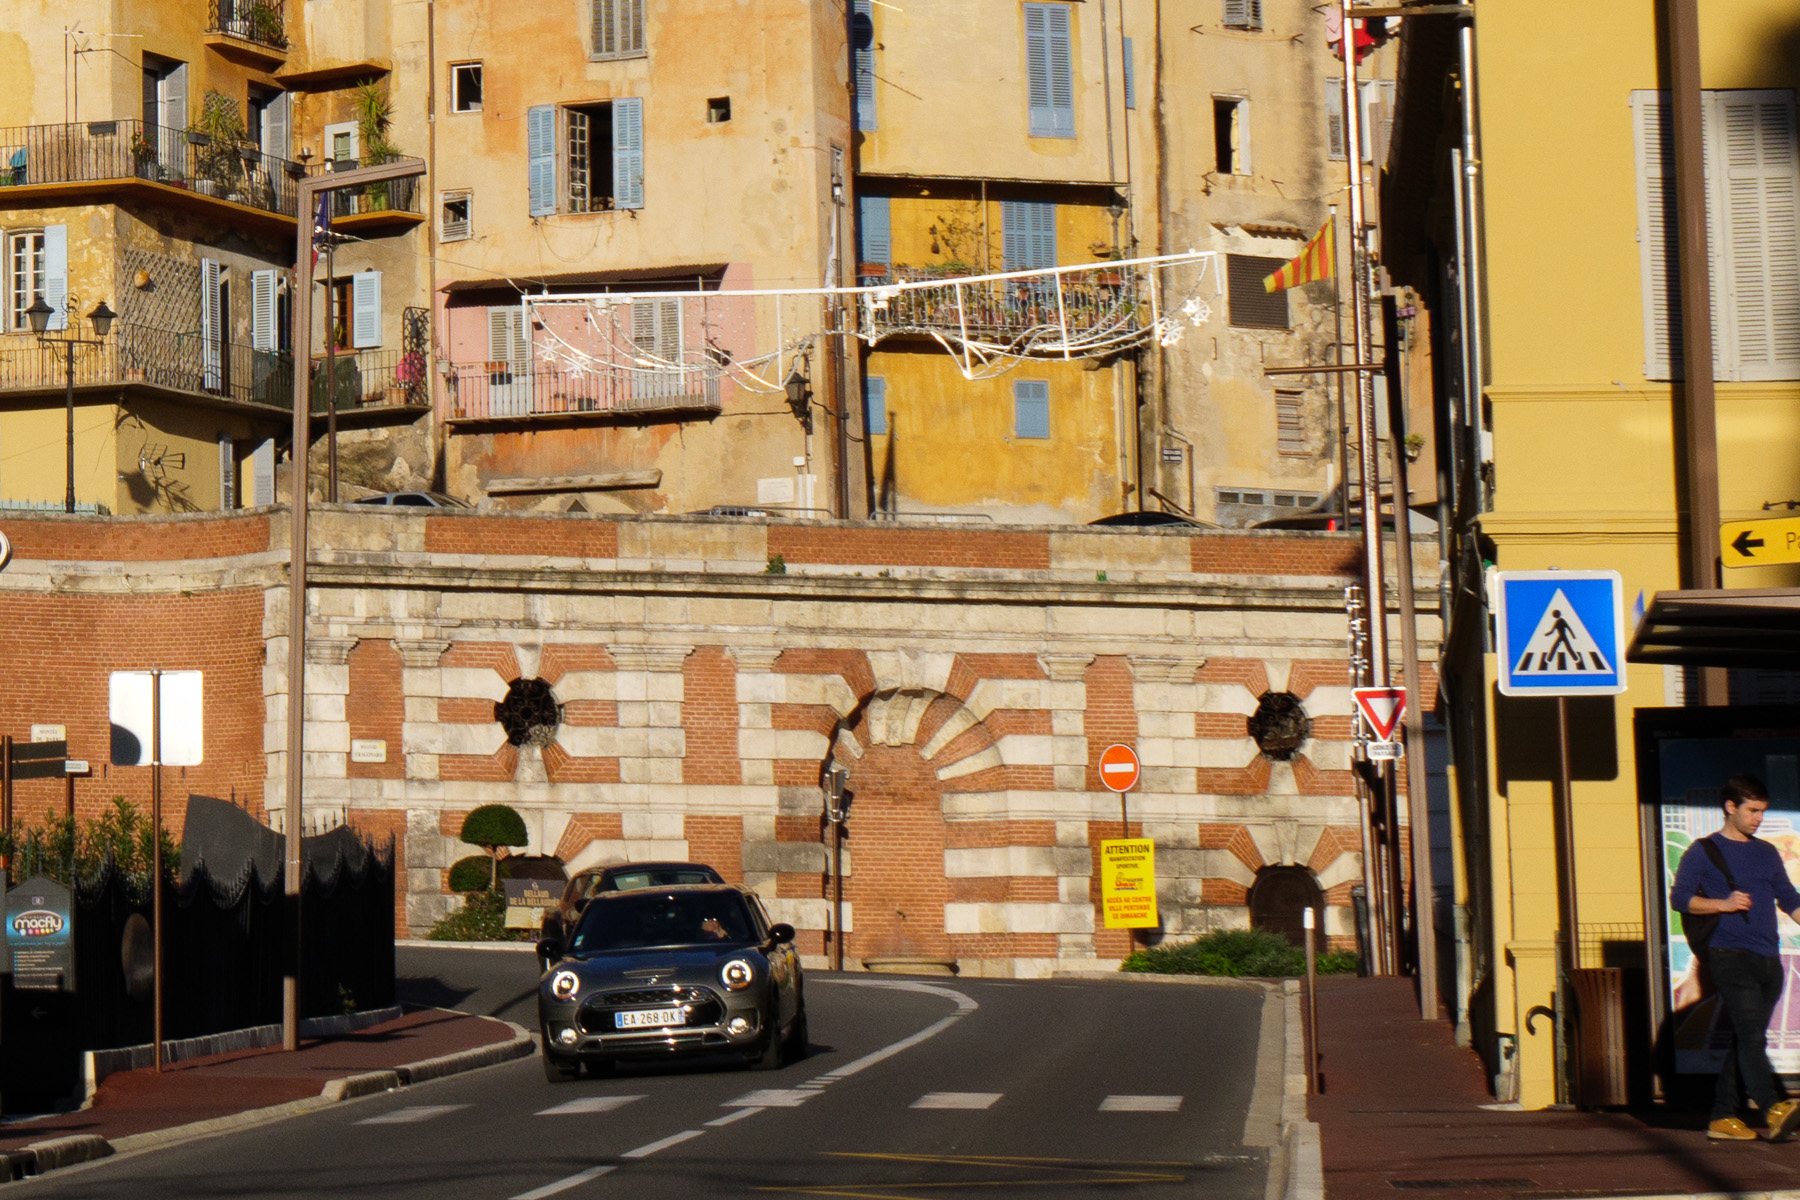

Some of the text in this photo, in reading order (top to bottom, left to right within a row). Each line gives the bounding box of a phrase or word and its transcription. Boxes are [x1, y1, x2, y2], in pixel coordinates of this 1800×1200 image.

[1786, 532, 1800, 550] P
[1105, 844, 1150, 854] ATTENTION
[15, 916, 62, 931] macfly
